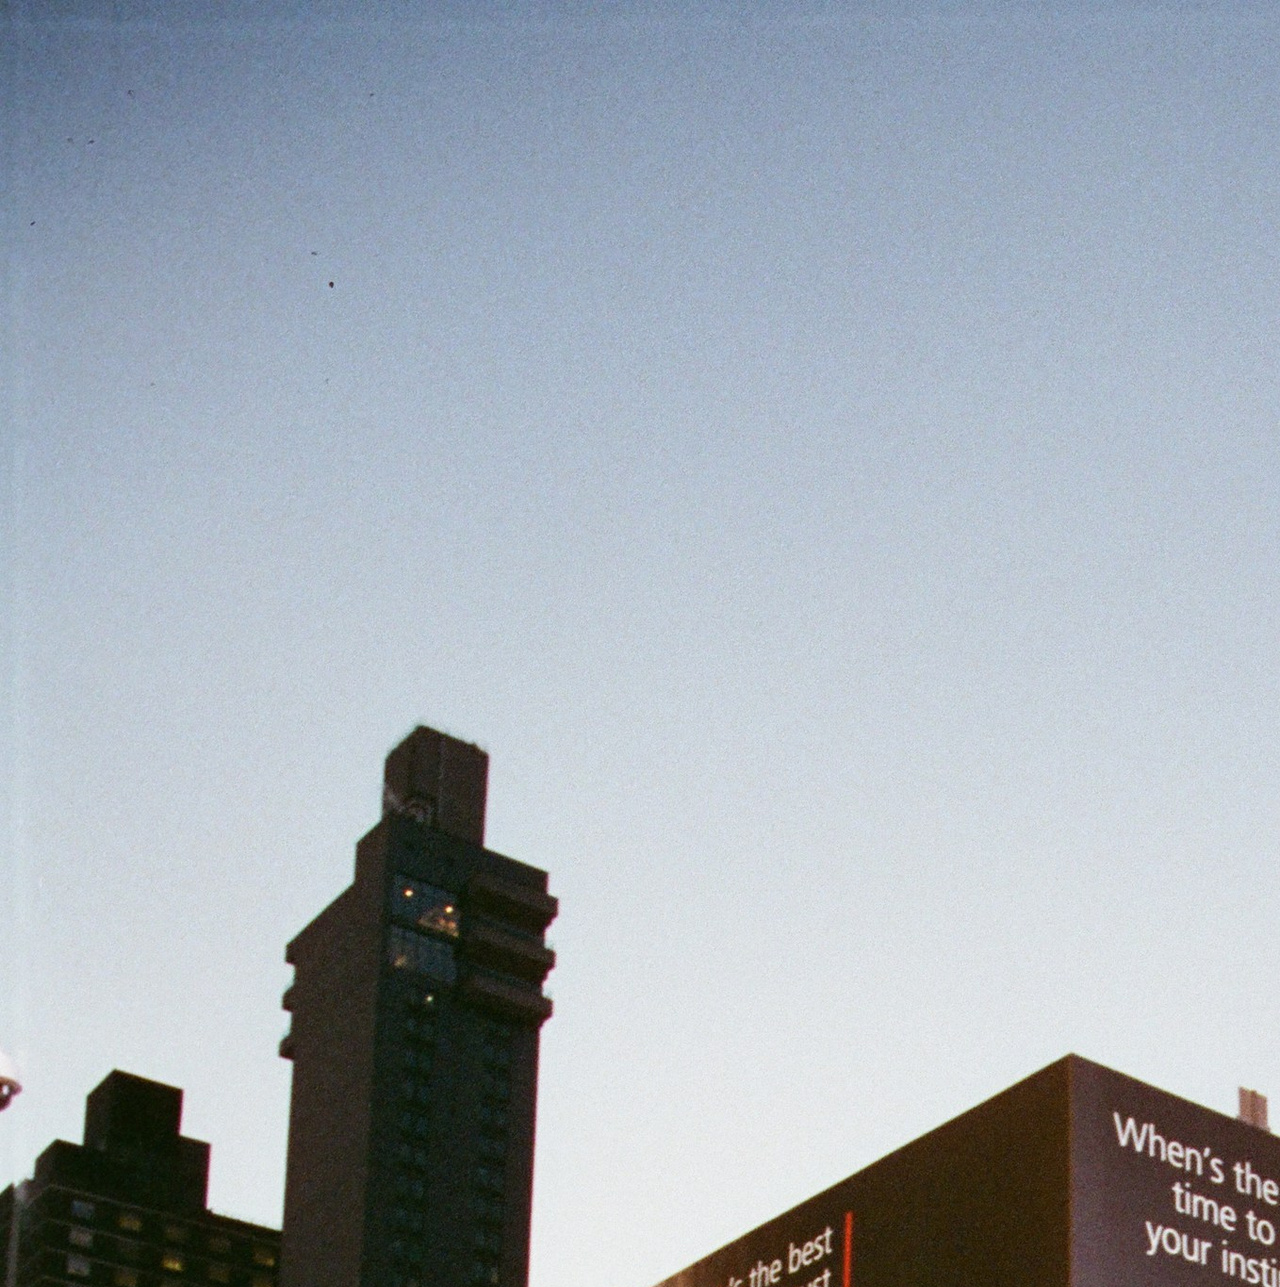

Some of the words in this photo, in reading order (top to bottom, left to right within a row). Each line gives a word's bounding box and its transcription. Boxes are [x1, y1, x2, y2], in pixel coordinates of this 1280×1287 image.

[1113, 1111, 1225, 1184] When's
[1233, 1160, 1280, 1205] the
[1172, 1181, 1236, 1231] time
[1246, 1207, 1275, 1245] to
[788, 1227, 833, 1274] best
[1145, 1221, 1212, 1266] your
